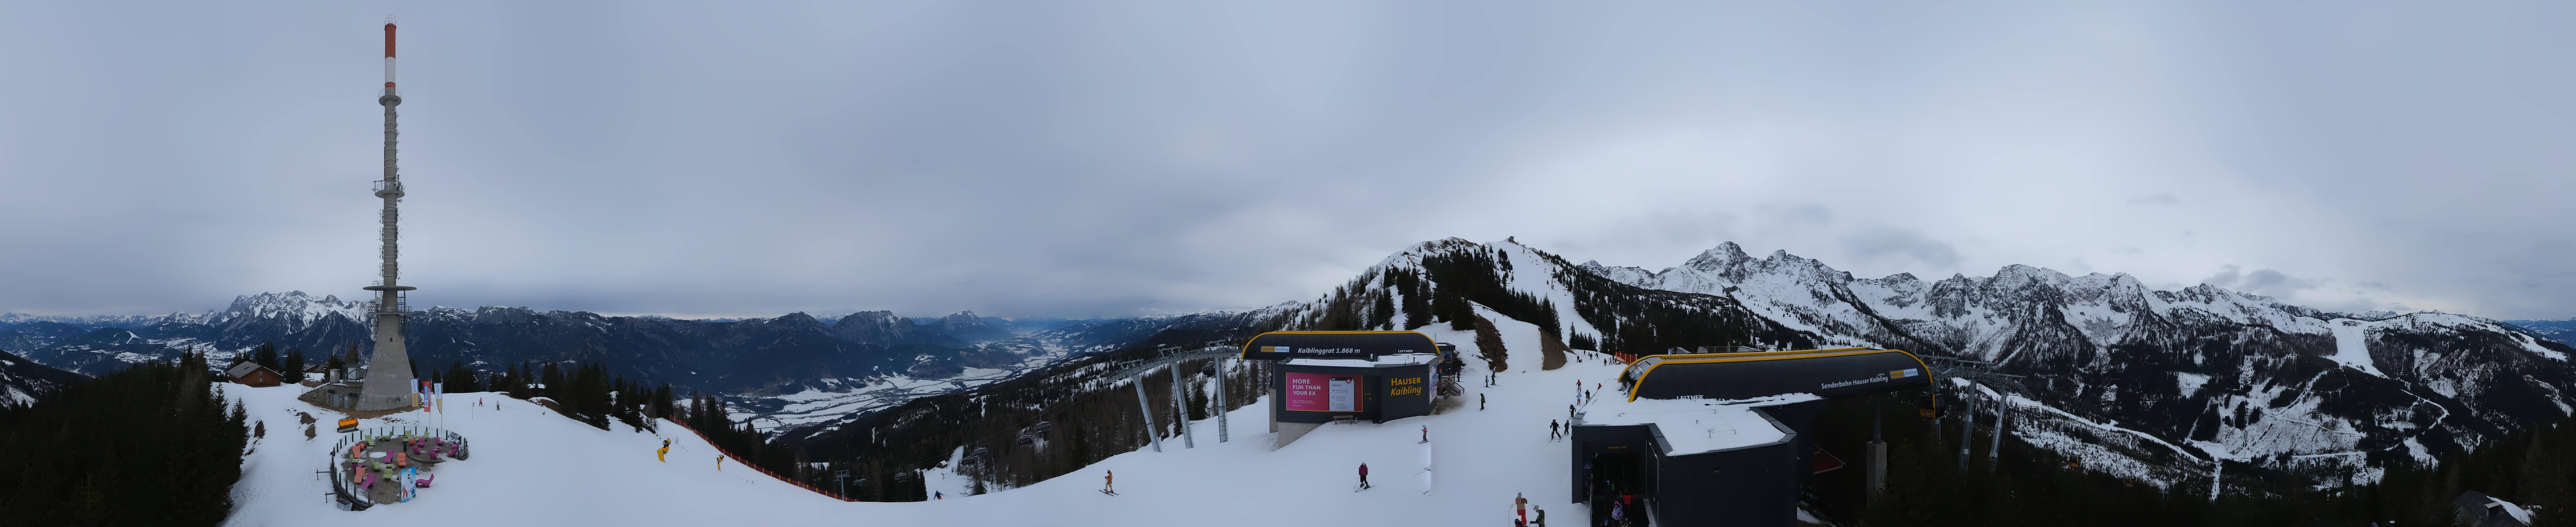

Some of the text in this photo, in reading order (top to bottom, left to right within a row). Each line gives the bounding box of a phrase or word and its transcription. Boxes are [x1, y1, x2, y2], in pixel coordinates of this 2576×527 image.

[1391, 377, 1421, 386] HAUSER
[1821, 380, 1852, 389] Senderbahn
[1391, 386, 1421, 396] Kaibling
